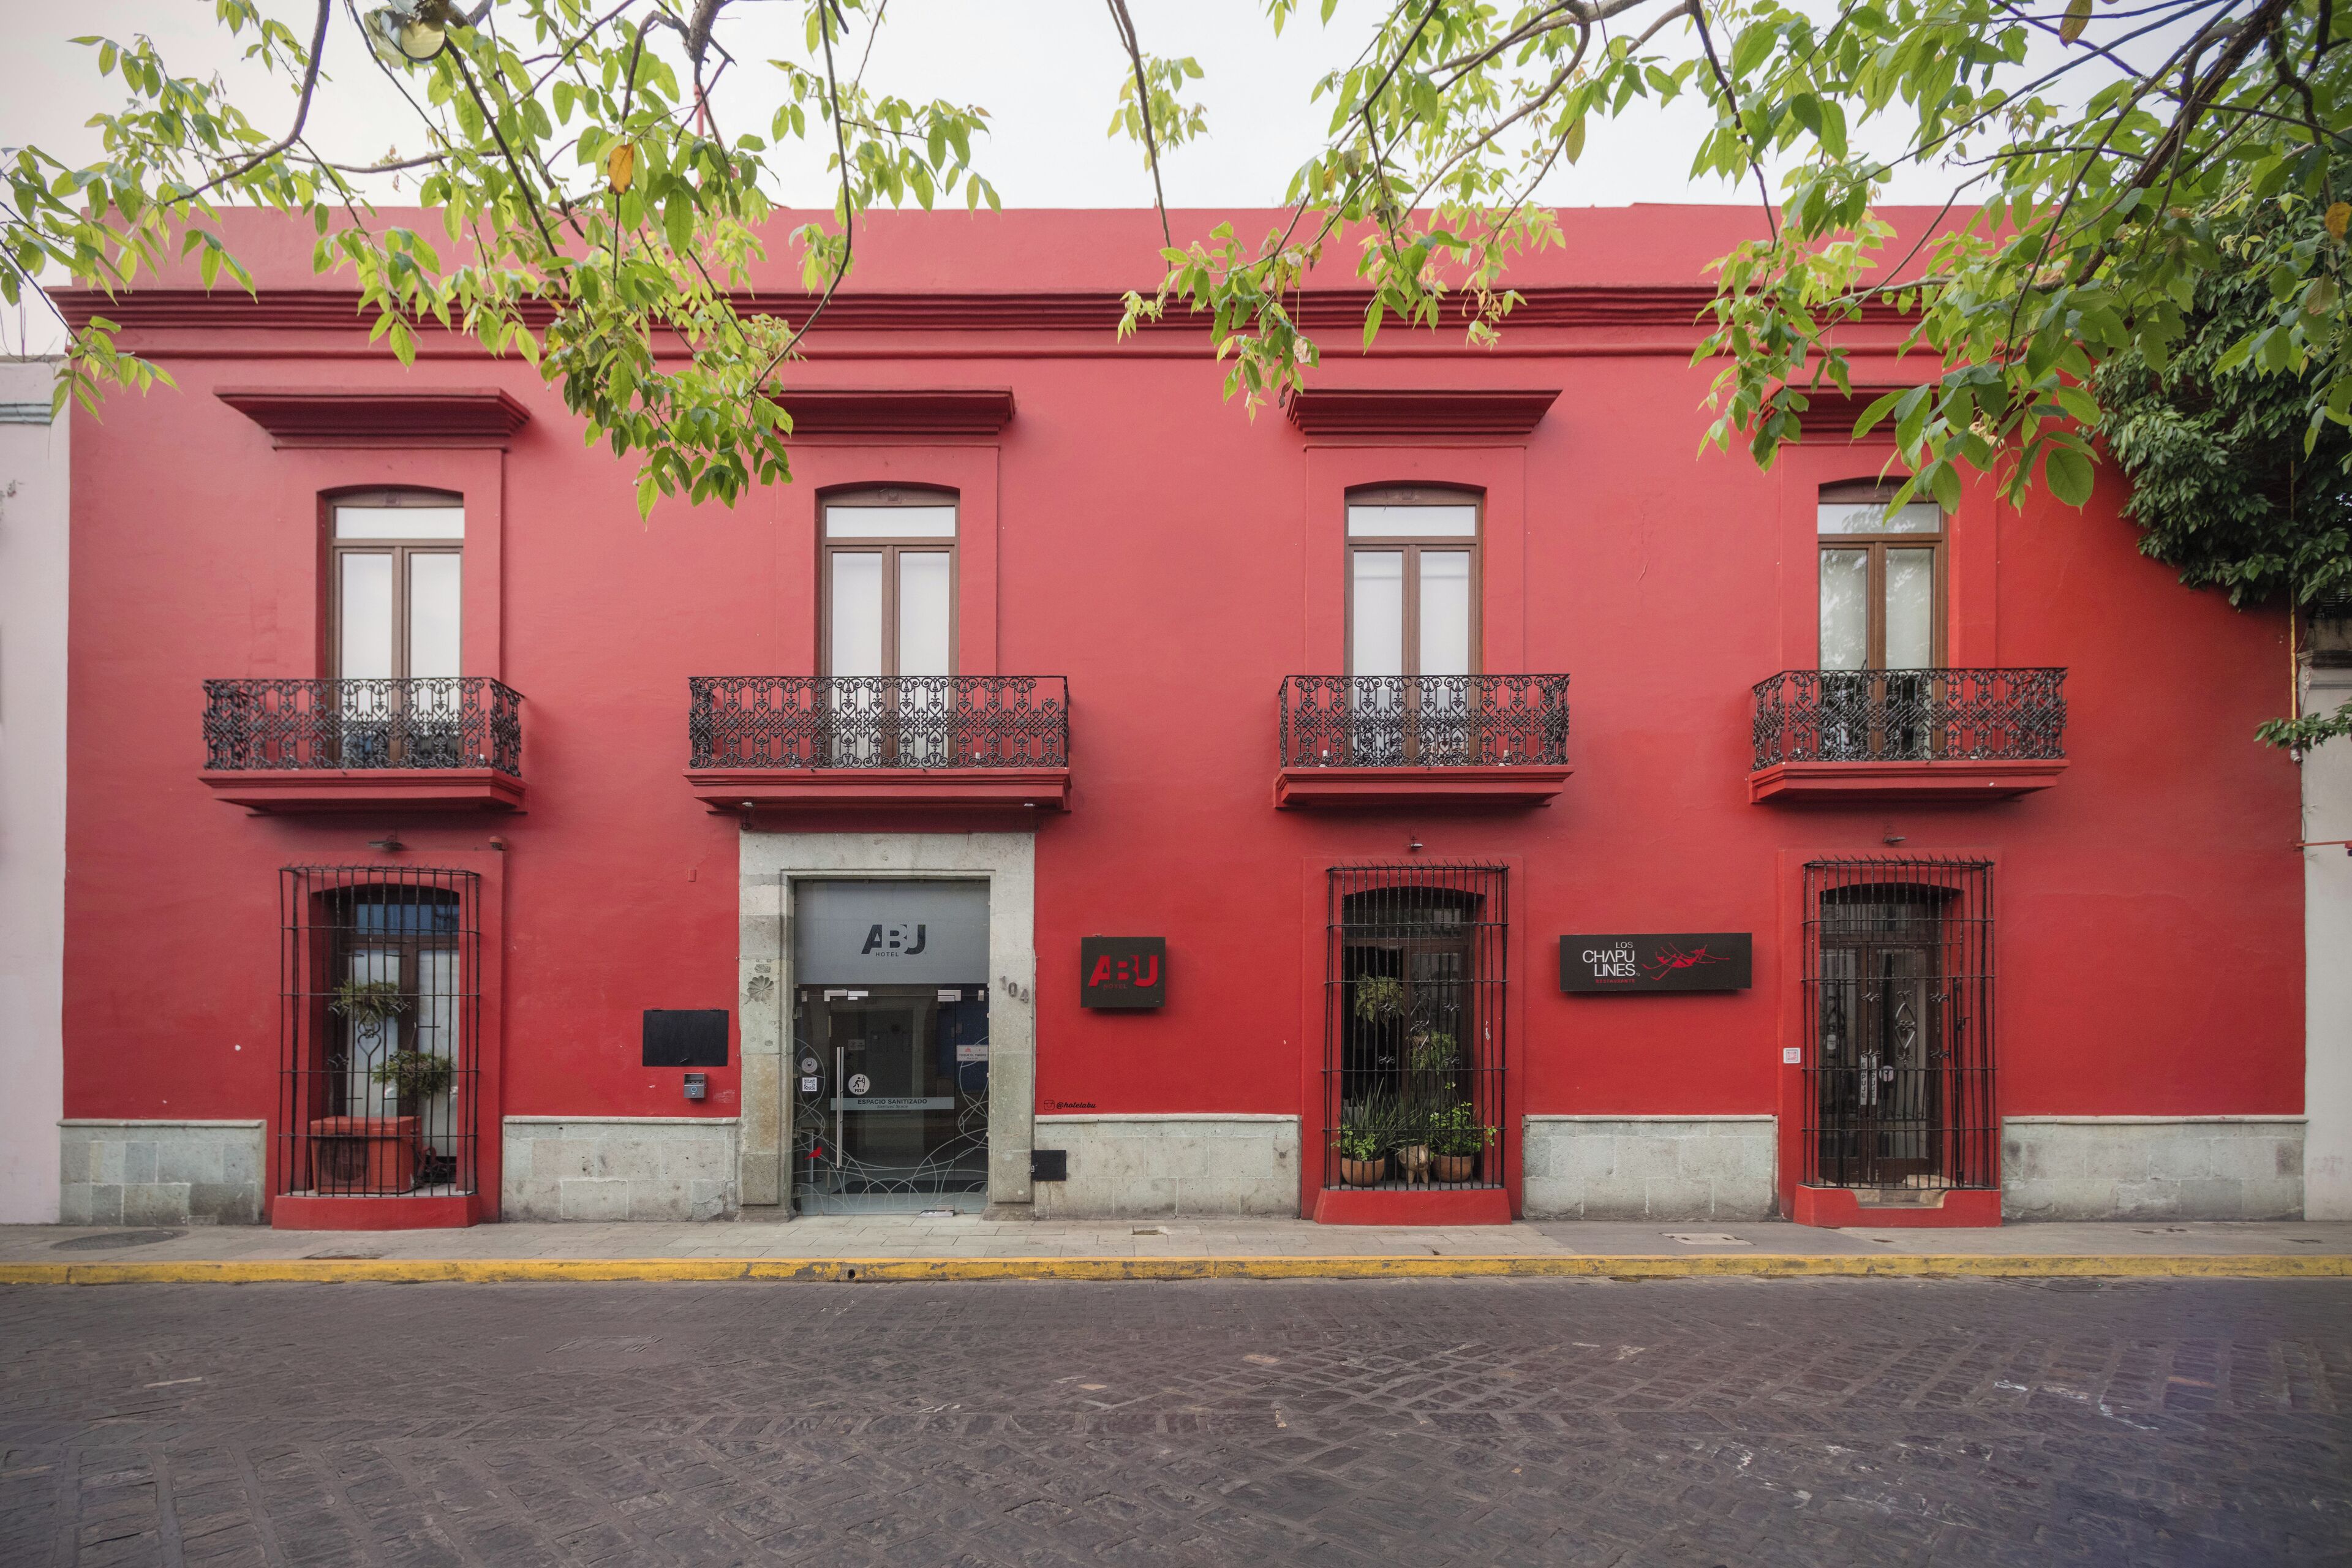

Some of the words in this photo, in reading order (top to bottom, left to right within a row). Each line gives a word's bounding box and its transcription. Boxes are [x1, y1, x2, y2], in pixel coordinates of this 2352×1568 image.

[861, 924, 926, 955] ABU
[1088, 954, 1159, 987] ABU
[1582, 950, 1635, 963] CHAPU
[1594, 963, 1636, 977] LINES
[998, 974, 1030, 1003] 104
